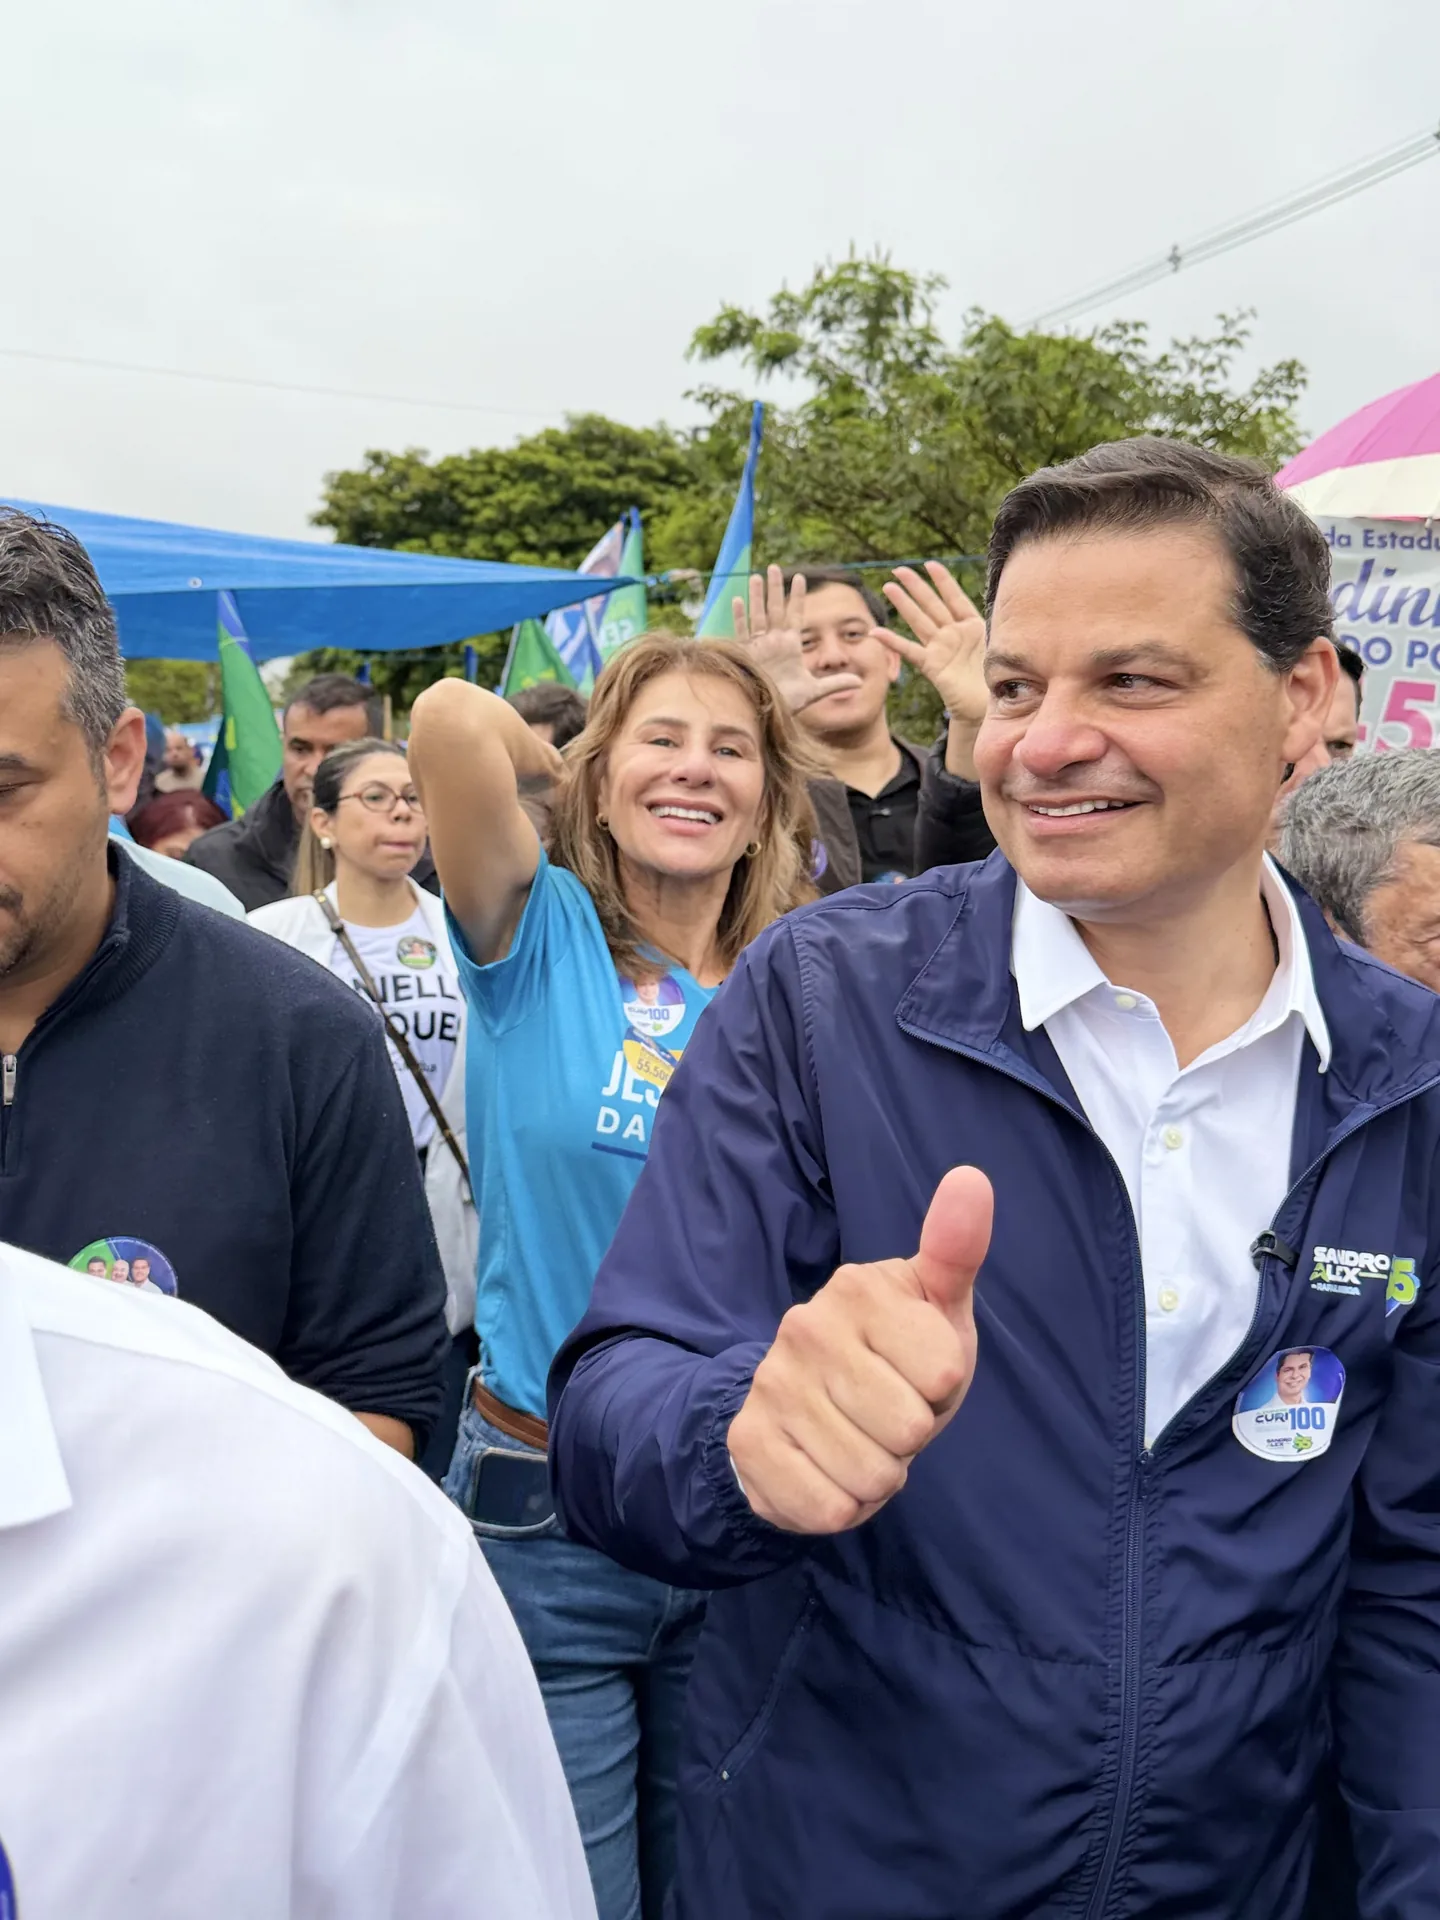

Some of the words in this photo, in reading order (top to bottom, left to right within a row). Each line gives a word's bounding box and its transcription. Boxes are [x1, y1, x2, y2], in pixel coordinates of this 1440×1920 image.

[386, 1011, 460, 1042] QUE
[1313, 1246, 1391, 1273] SANDRO
[1288, 1406, 1326, 1430] 100
